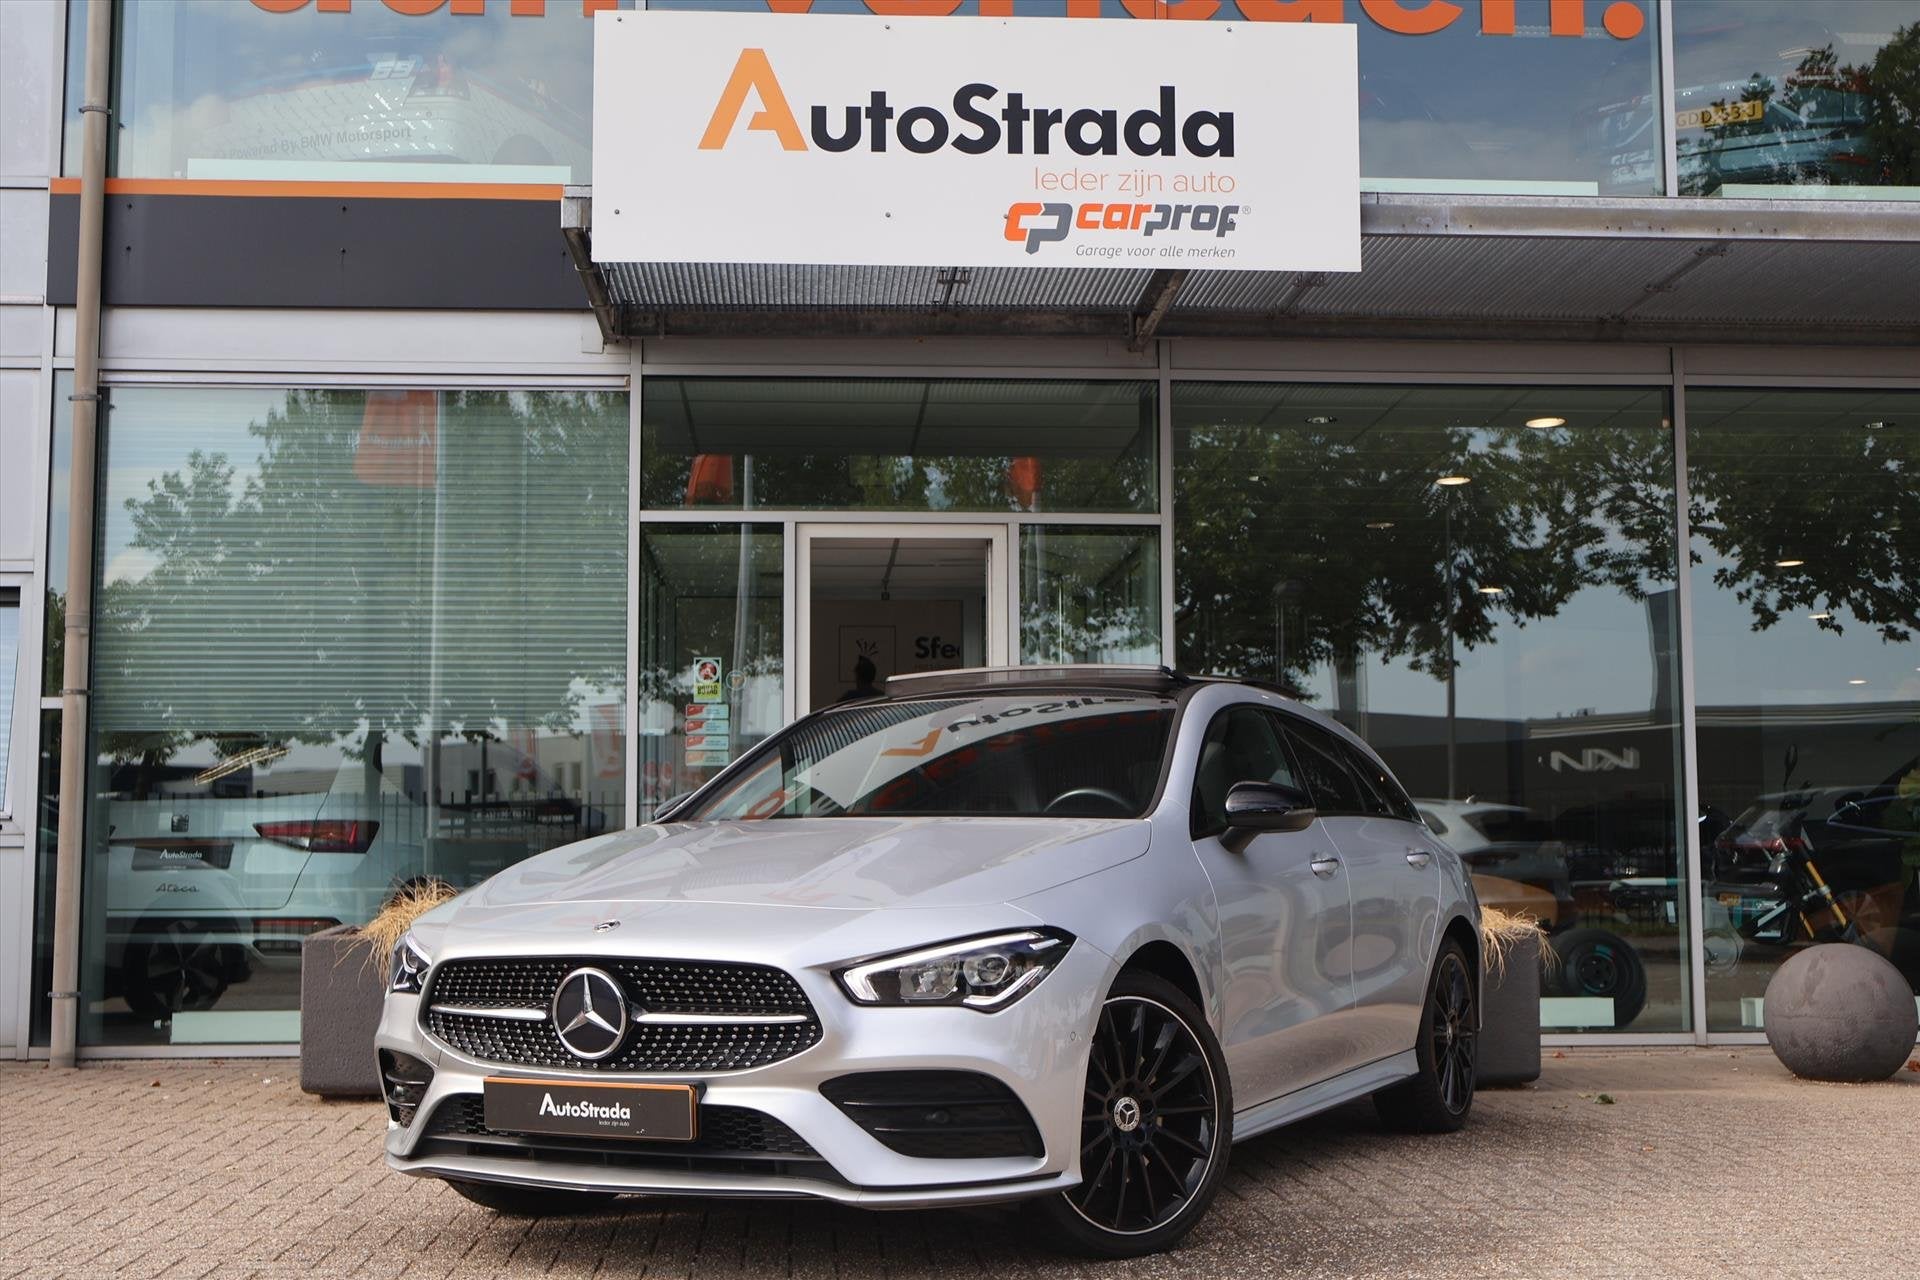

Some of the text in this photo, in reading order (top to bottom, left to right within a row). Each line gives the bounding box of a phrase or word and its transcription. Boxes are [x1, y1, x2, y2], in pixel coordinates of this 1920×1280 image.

[698, 47, 1236, 159] AutoStrada
[300, 133, 333, 149] BMW
[336, 127, 412, 145] Motorsport
[1035, 167, 1236, 199] Ieder zijn auto
[1076, 244, 1236, 259] Garage voor alle merken
[914, 635, 960, 659] Sfe
[159, 848, 203, 860] AutoStrada
[155, 882, 200, 893] Ateca
[538, 1092, 631, 1120] AutoStrada
